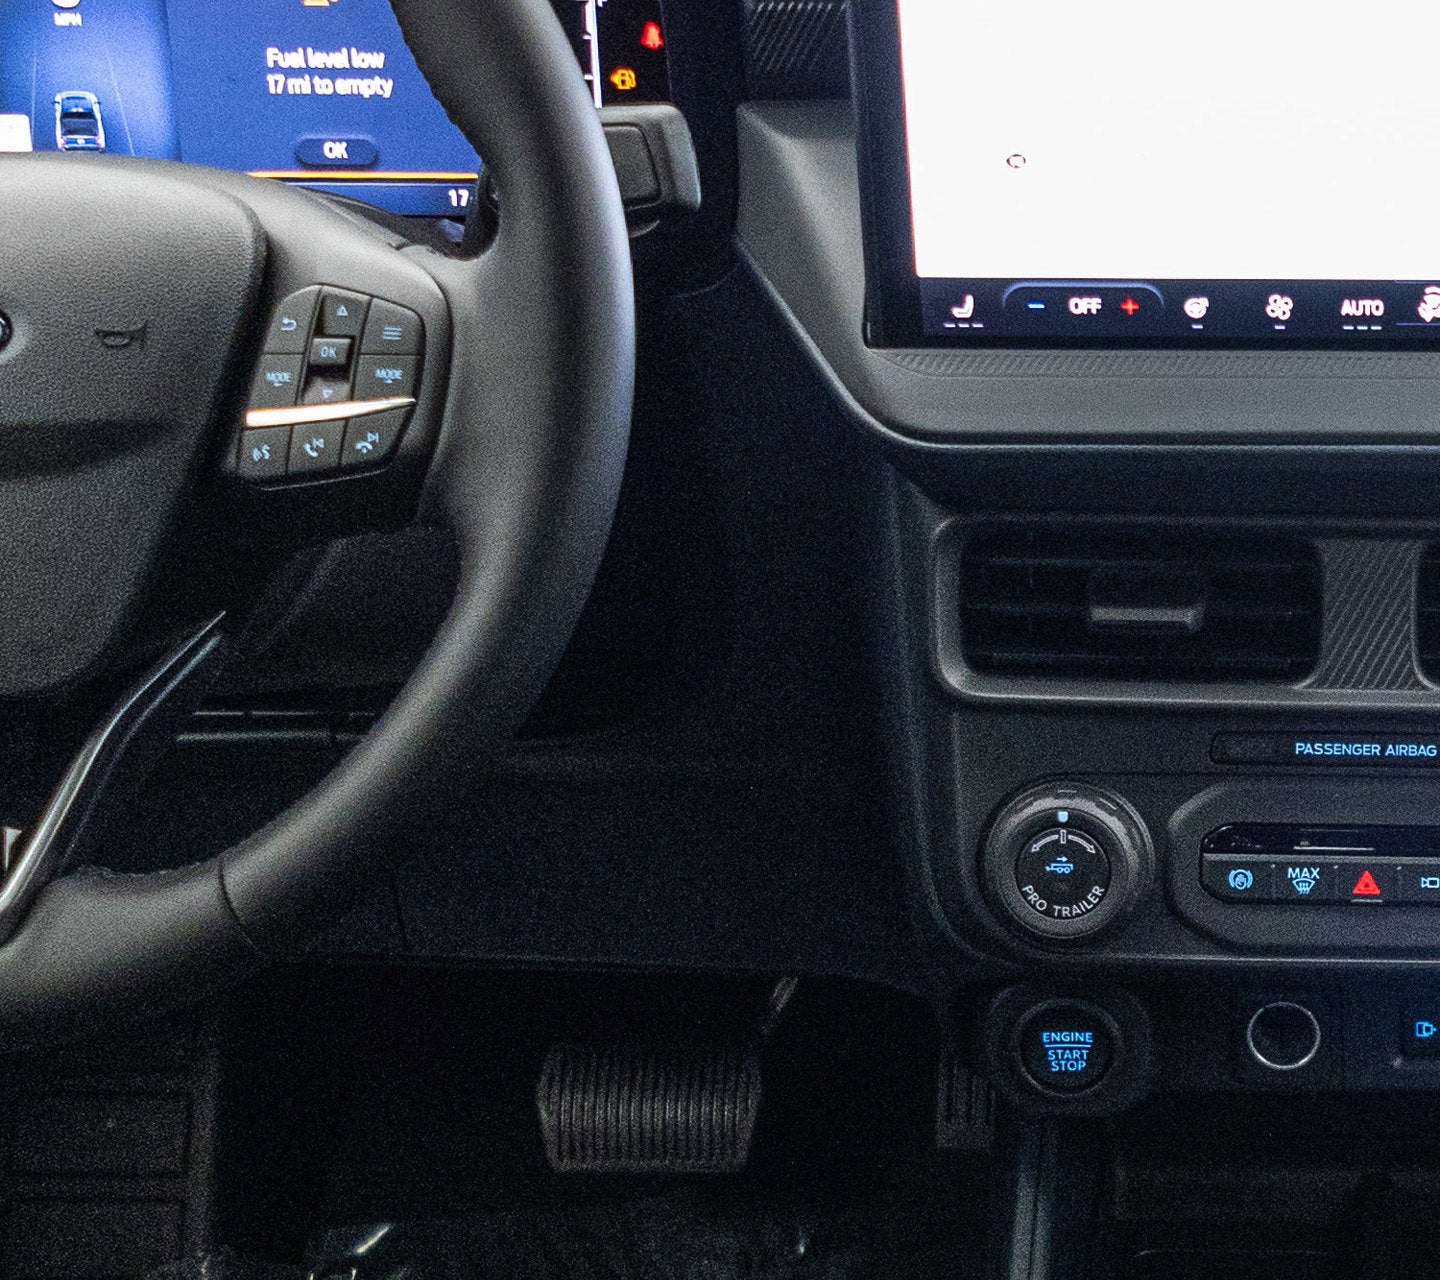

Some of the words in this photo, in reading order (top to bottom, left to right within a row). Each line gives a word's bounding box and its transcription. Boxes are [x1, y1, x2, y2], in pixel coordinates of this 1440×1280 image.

[266, 47, 306, 69] Fuel
[307, 47, 350, 69] level
[350, 47, 385, 69] low
[266, 74, 286, 95] 17
[287, 75, 311, 95] mi
[313, 76, 334, 95] to
[335, 76, 394, 99] empty
[322, 141, 348, 159] OK
[448, 189, 469, 207] 17
[1068, 298, 1102, 315] OFF
[1340, 300, 1385, 317] AUTO
[320, 346, 337, 358] OK
[265, 371, 293, 383] MODE
[374, 368, 404, 381] MODE
[1295, 742, 1381, 756] PASSENGER
[1385, 744, 1437, 757] AIRBAG
[1287, 867, 1320, 879] MAX
[1022, 885, 1047, 910] PRO
[1053, 885, 1105, 917] TRAILER
[1042, 1031, 1093, 1043] ENGINE
[1047, 1049, 1089, 1060] START
[1051, 1060, 1086, 1072] STOP
